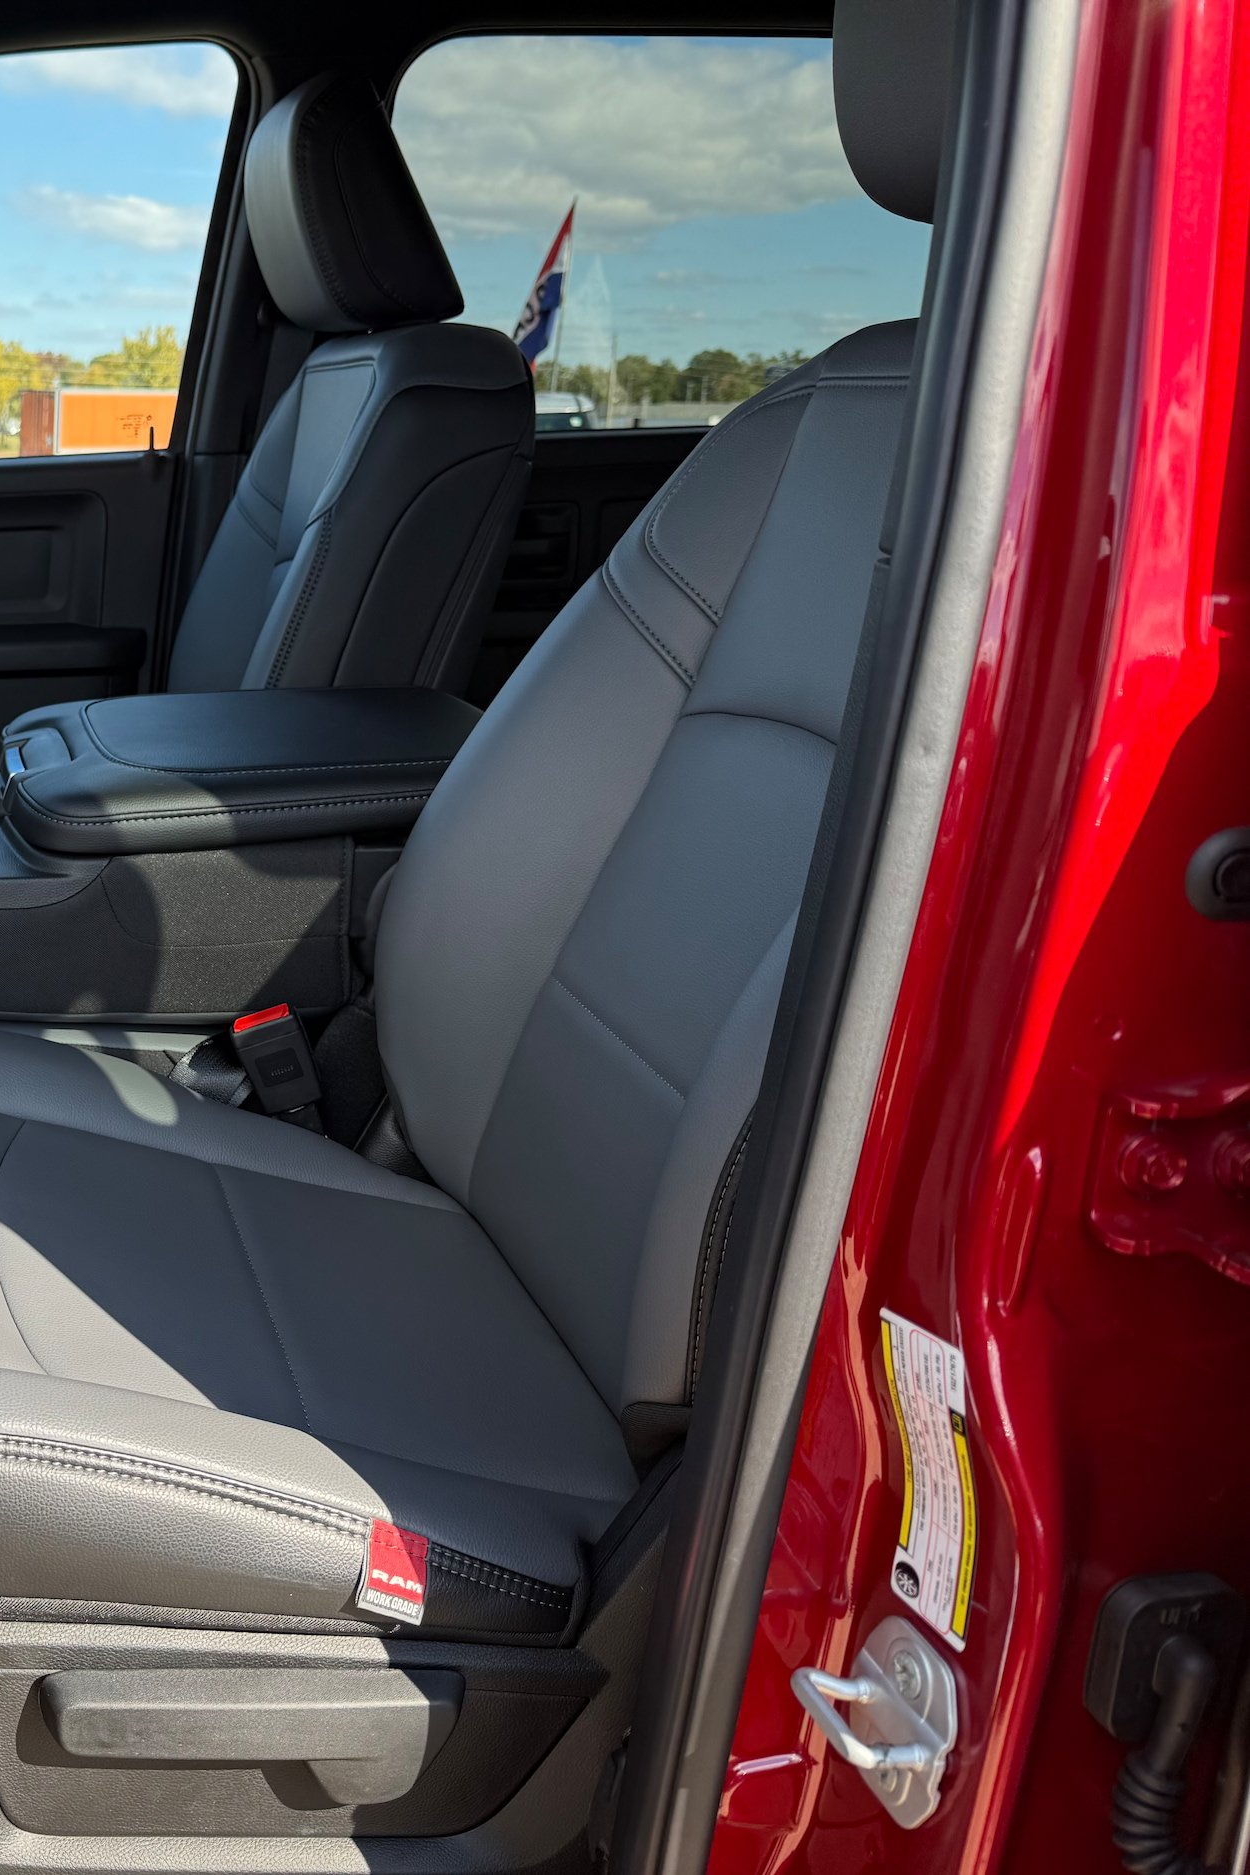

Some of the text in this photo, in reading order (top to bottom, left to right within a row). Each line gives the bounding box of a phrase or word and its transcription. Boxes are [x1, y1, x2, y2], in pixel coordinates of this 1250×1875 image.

[371, 1569, 425, 1594] RAM
[366, 1589, 420, 1616] WORK GRADE
